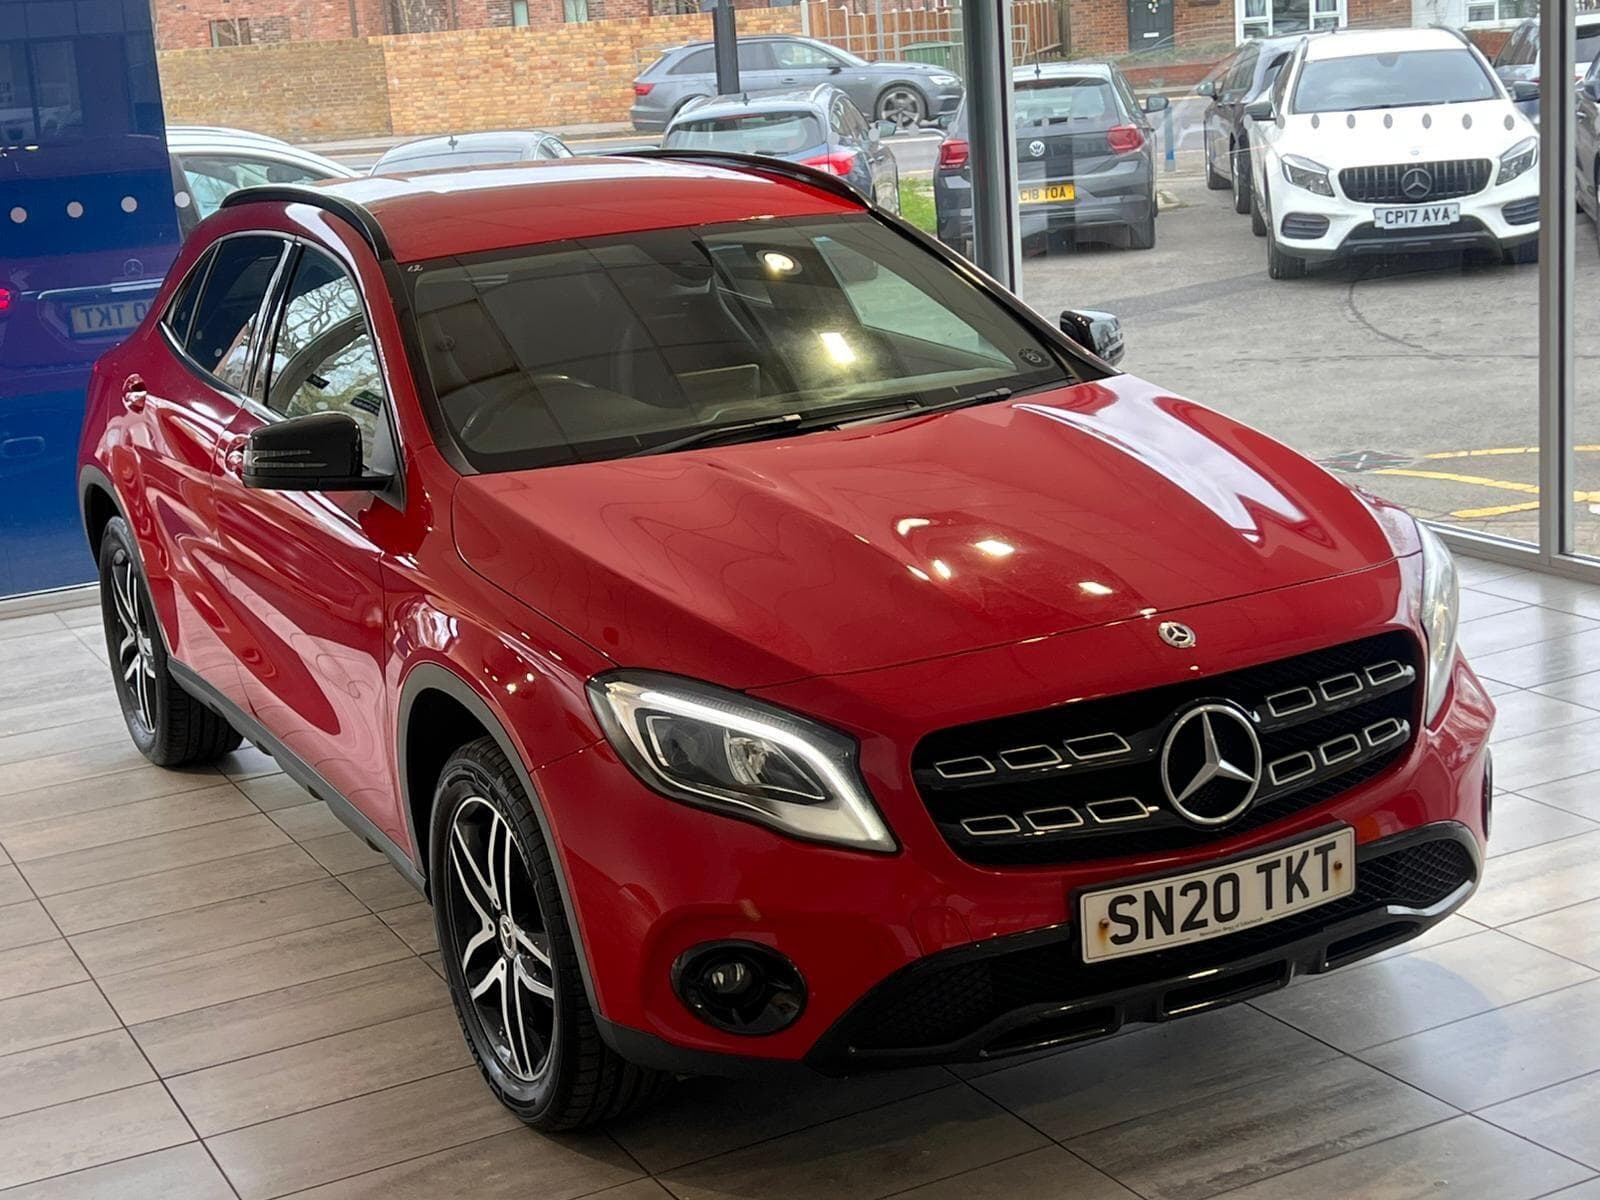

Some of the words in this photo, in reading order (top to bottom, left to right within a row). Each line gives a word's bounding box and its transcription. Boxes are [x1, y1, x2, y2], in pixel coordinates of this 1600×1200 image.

[1044, 186, 1066, 199] TOA
[1384, 209, 1418, 224] CP17
[1422, 207, 1450, 222] AYA
[1107, 872, 1241, 946] SN20
[1256, 840, 1337, 911] TKT
